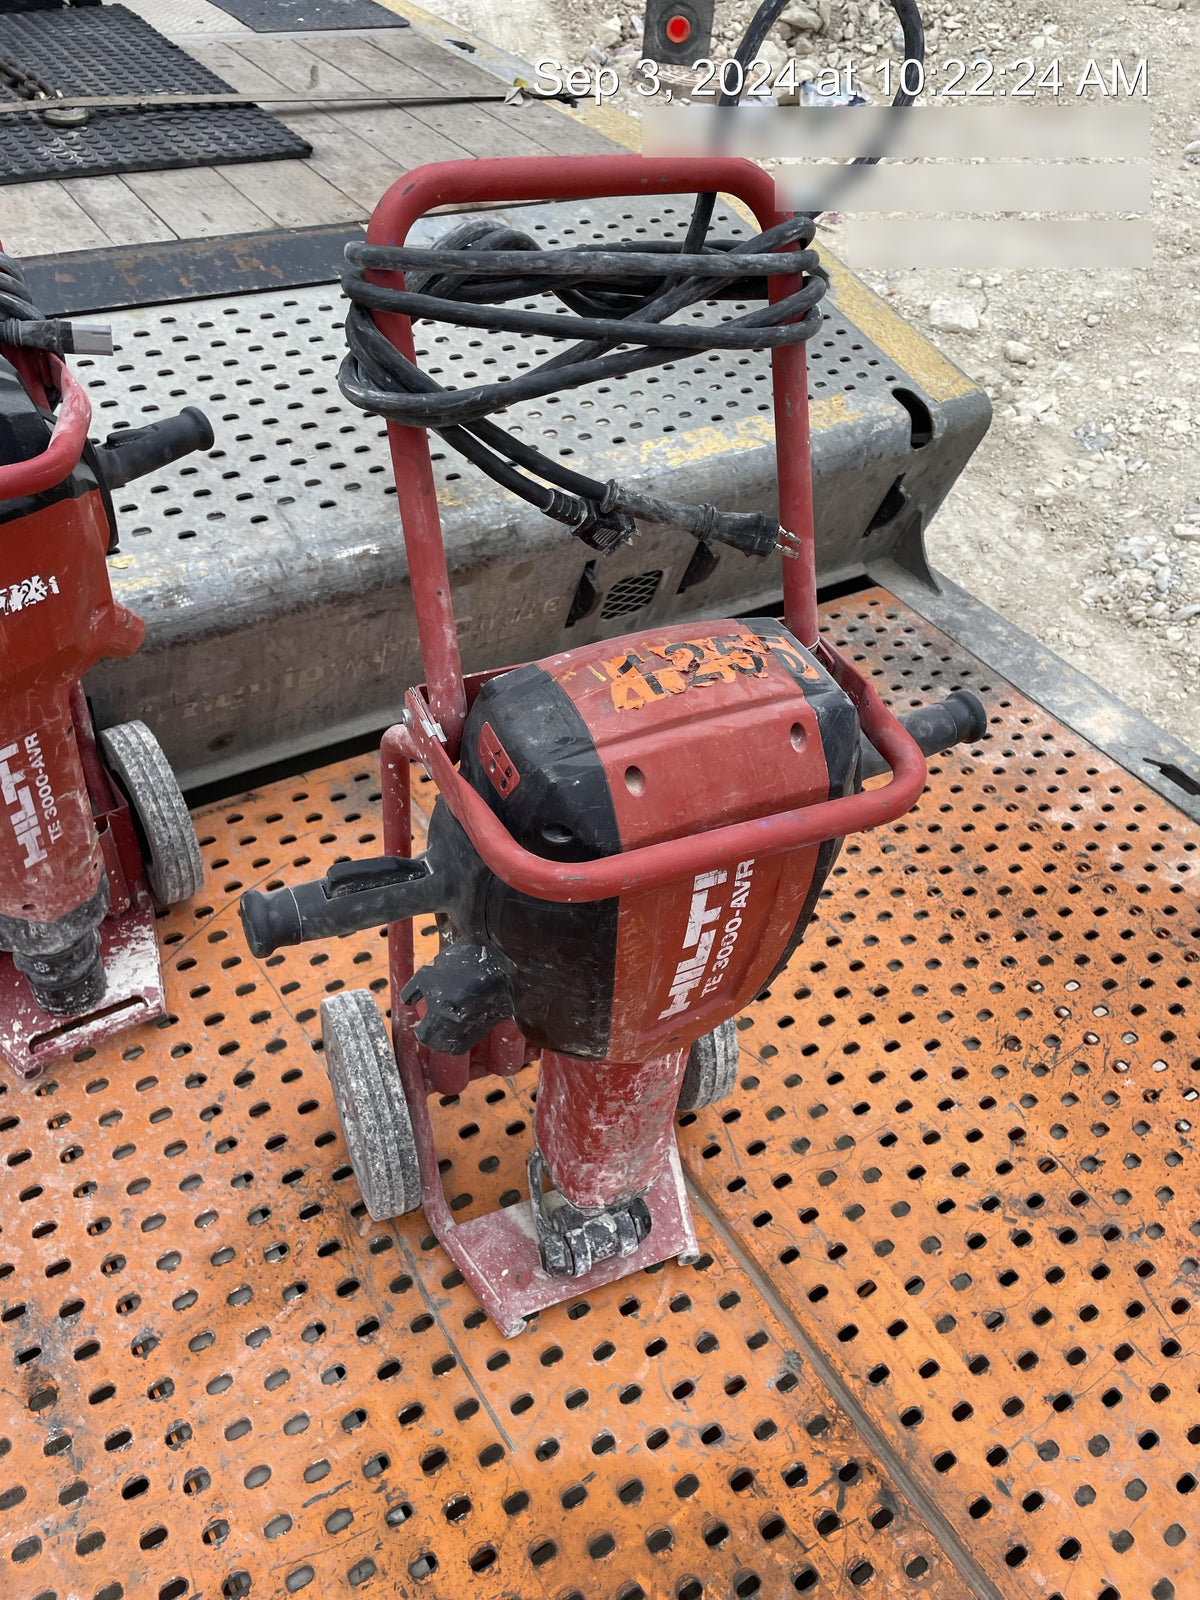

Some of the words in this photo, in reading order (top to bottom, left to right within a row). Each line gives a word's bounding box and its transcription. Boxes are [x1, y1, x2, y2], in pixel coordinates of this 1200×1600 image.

[0, 742, 48, 869] HILTI
[24, 732, 58, 820] 3000-AVR
[47, 819, 62, 845] TE
[658, 869, 728, 1020] HILTI
[700, 973, 724, 998] TE
[712, 859, 755, 973] 3000-AVR
